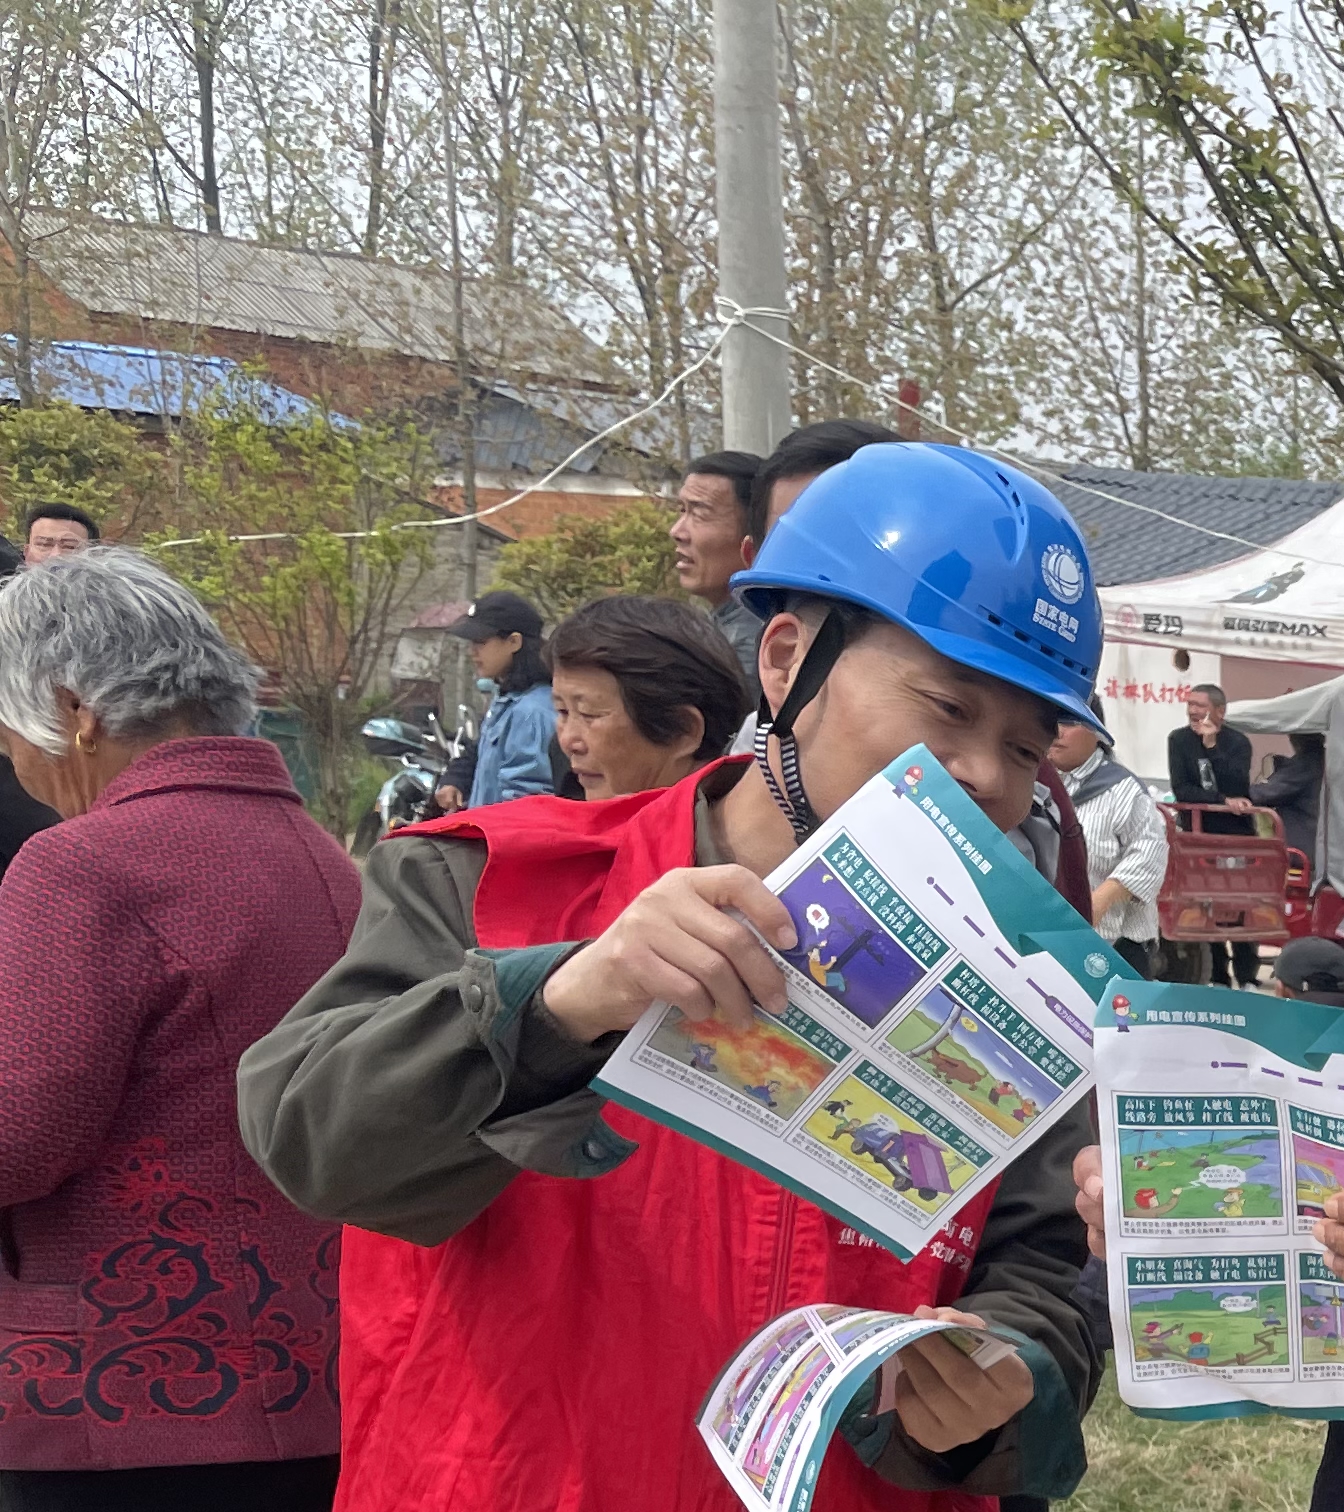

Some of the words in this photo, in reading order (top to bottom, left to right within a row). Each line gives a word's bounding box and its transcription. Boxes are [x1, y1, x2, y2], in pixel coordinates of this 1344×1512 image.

[1035, 598, 1080, 634] 国家电网
[1143, 613, 1183, 637] 爱玛
[920, 796, 993, 875] 用电宣传系列挂图
[1146, 1009, 1246, 1027] 用电宣传系列挂图
